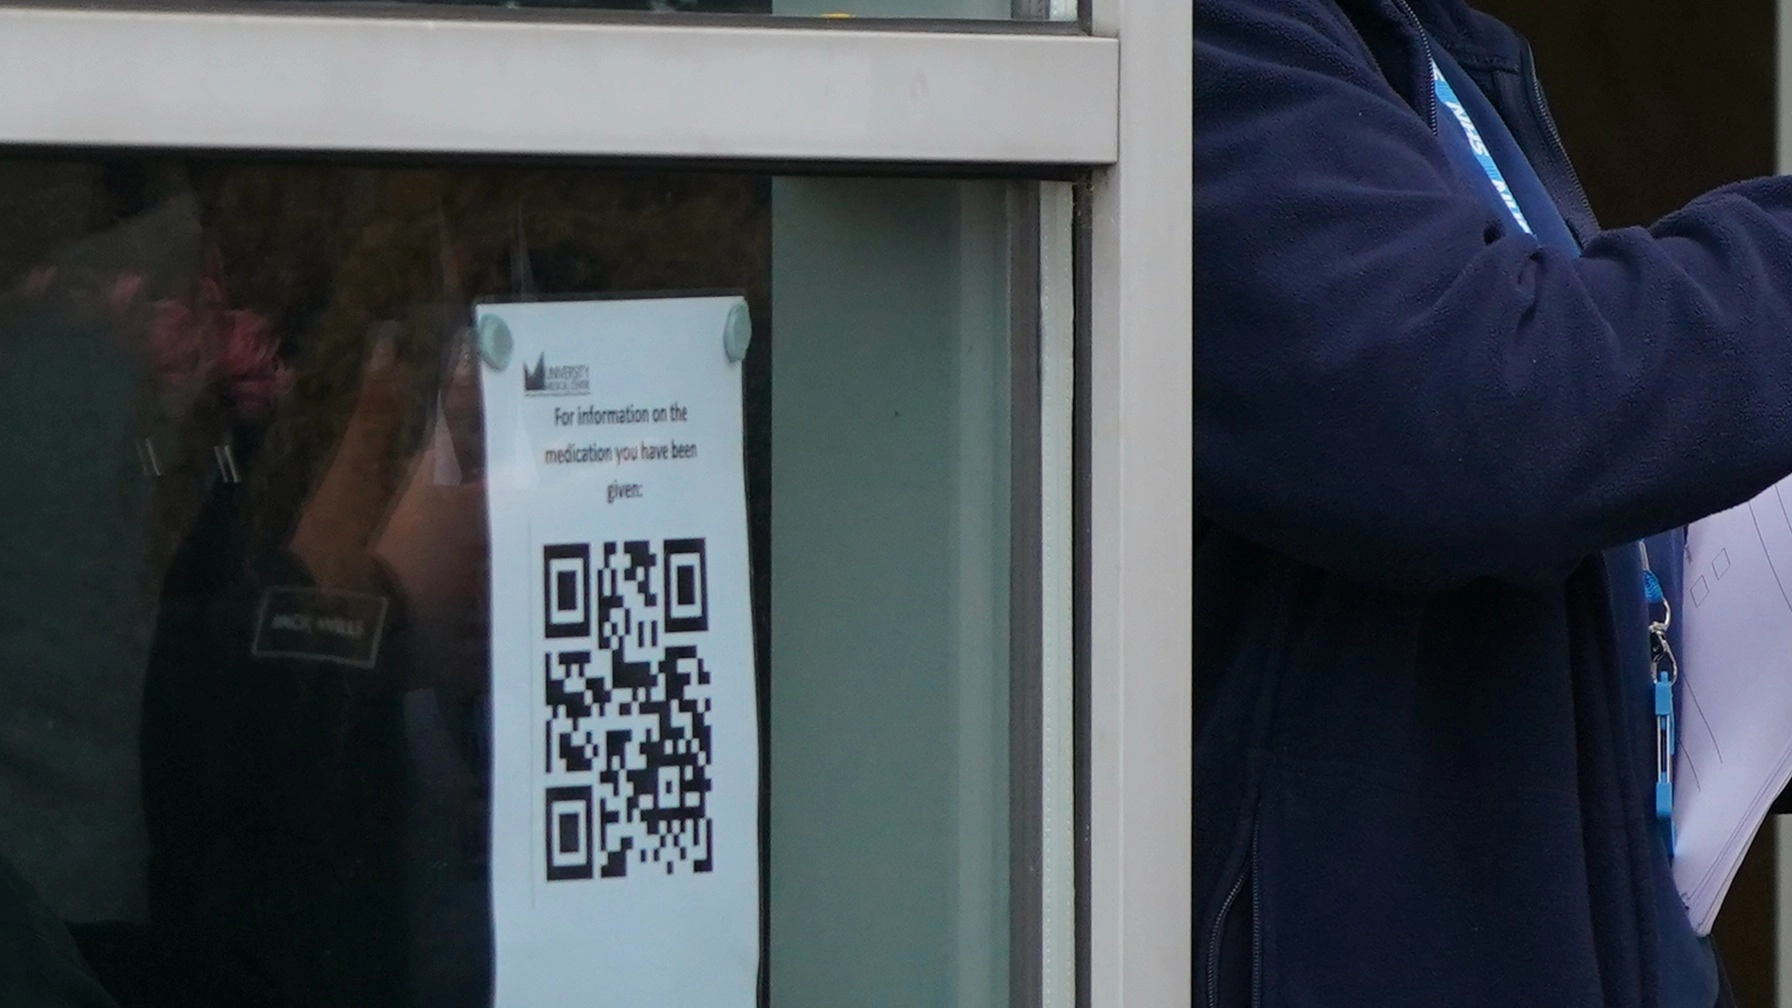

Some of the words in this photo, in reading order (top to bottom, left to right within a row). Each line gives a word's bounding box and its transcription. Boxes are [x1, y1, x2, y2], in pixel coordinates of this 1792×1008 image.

[554, 407, 575, 426] For
[577, 405, 649, 425] information
[652, 407, 668, 423] on
[670, 402, 688, 422] the
[545, 442, 612, 465] medication
[615, 446, 639, 465] you
[641, 440, 669, 460] have
[671, 439, 698, 459] been
[607, 479, 643, 504] given:
